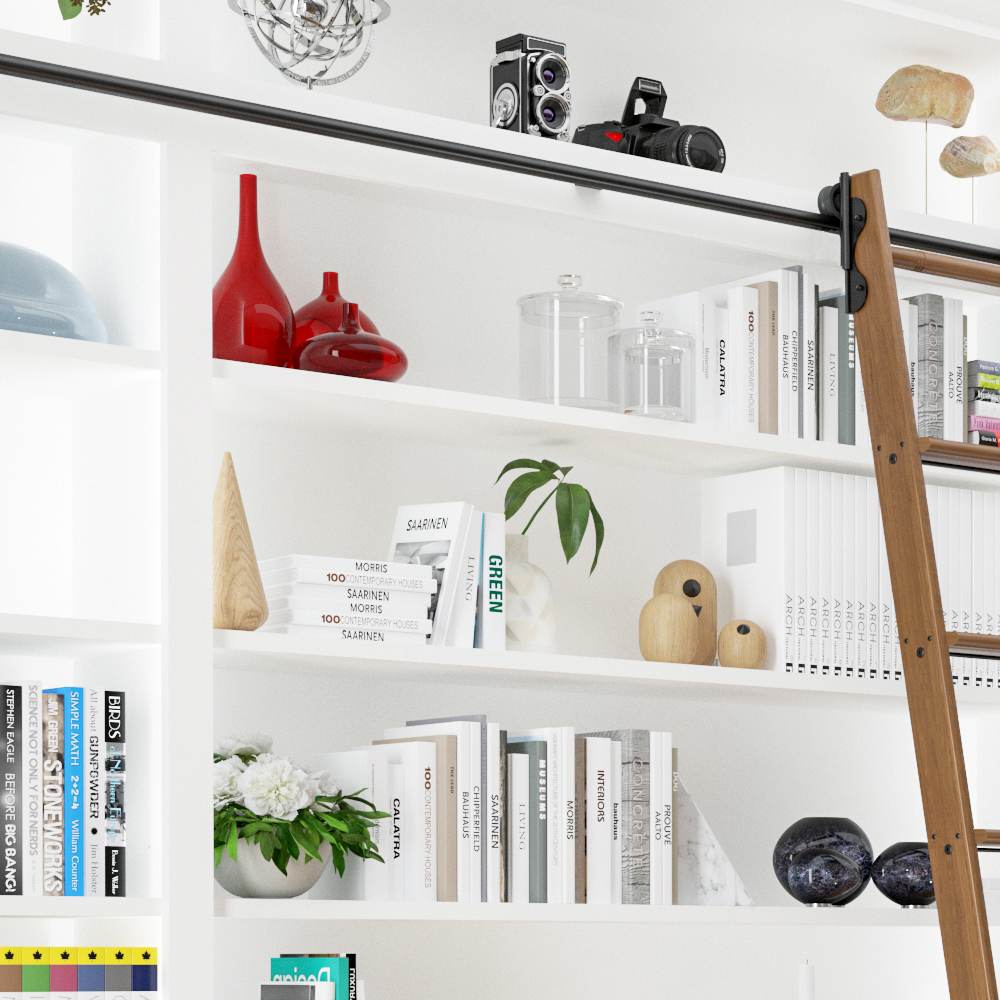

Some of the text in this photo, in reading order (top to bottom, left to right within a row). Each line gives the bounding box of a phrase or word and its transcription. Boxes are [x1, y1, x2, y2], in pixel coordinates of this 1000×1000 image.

[406, 518, 448, 531] SAARINEN
[326, 573, 346, 583] 100
[355, 562, 388, 573] MORRIS
[489, 555, 503, 613] GREEN
[347, 589, 390, 601] SAARINEN
[350, 603, 383, 614] MORRIS
[321, 615, 341, 624] 100
[342, 630, 385, 642] SAARINEN
[6, 689, 15, 729] STEPHEN
[70, 691, 80, 730] SIMPLE
[109, 695, 121, 739] BIRDS
[6, 732, 15, 763] EAGLE
[70, 732, 80, 766] MATH
[90, 736, 99, 819] GUNPOWDER
[538, 759, 546, 820] MUSEUMS
[597, 770, 605, 823] INTERIORS
[5, 774, 16, 820] BEFORE
[5, 825, 16, 846] BIG
[43, 759, 64, 894] STONEWORKS
[71, 820, 80, 852] William
[491, 794, 499, 849] SAARINEN
[566, 801, 575, 840] MORRIS
[71, 854, 80, 892] Counter
